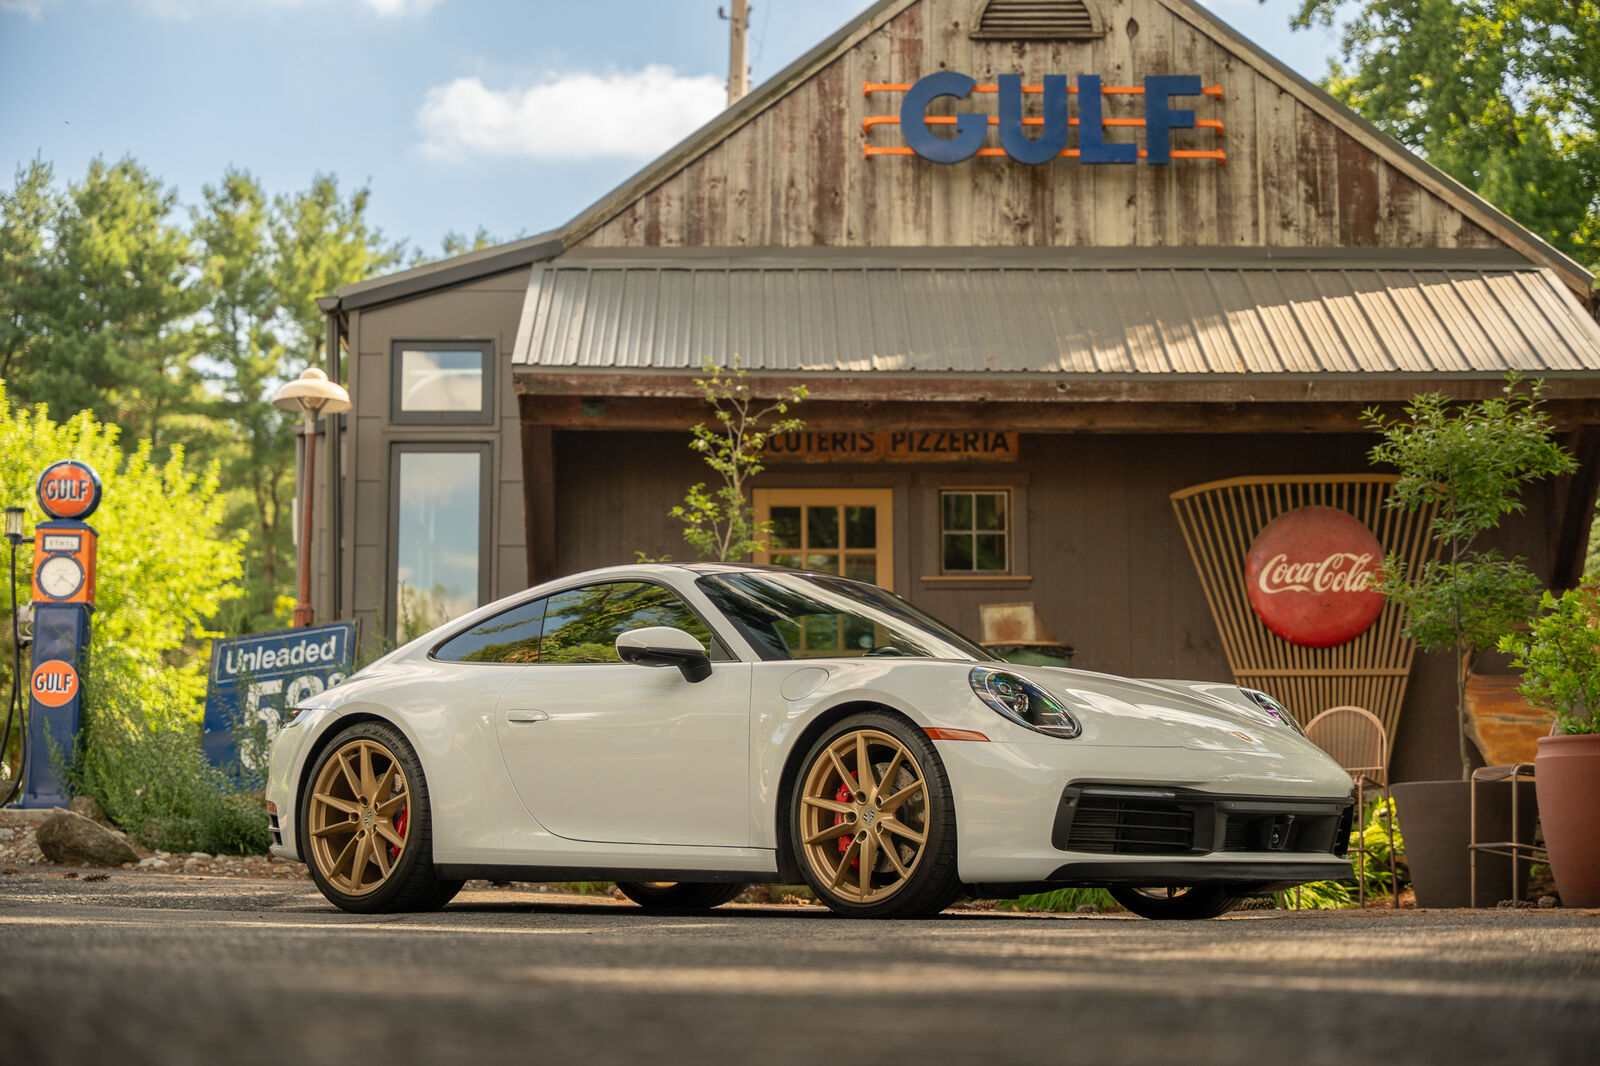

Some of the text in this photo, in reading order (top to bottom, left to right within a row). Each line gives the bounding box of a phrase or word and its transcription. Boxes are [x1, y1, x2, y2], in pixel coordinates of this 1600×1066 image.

[900, 71, 1202, 165] GULF
[891, 432, 1011, 452] PIZZERIA
[45, 479, 88, 500] GULF
[1259, 553, 1375, 594] Coca-Cola
[225, 635, 337, 674] Unleaded
[35, 672, 74, 693] GULF
